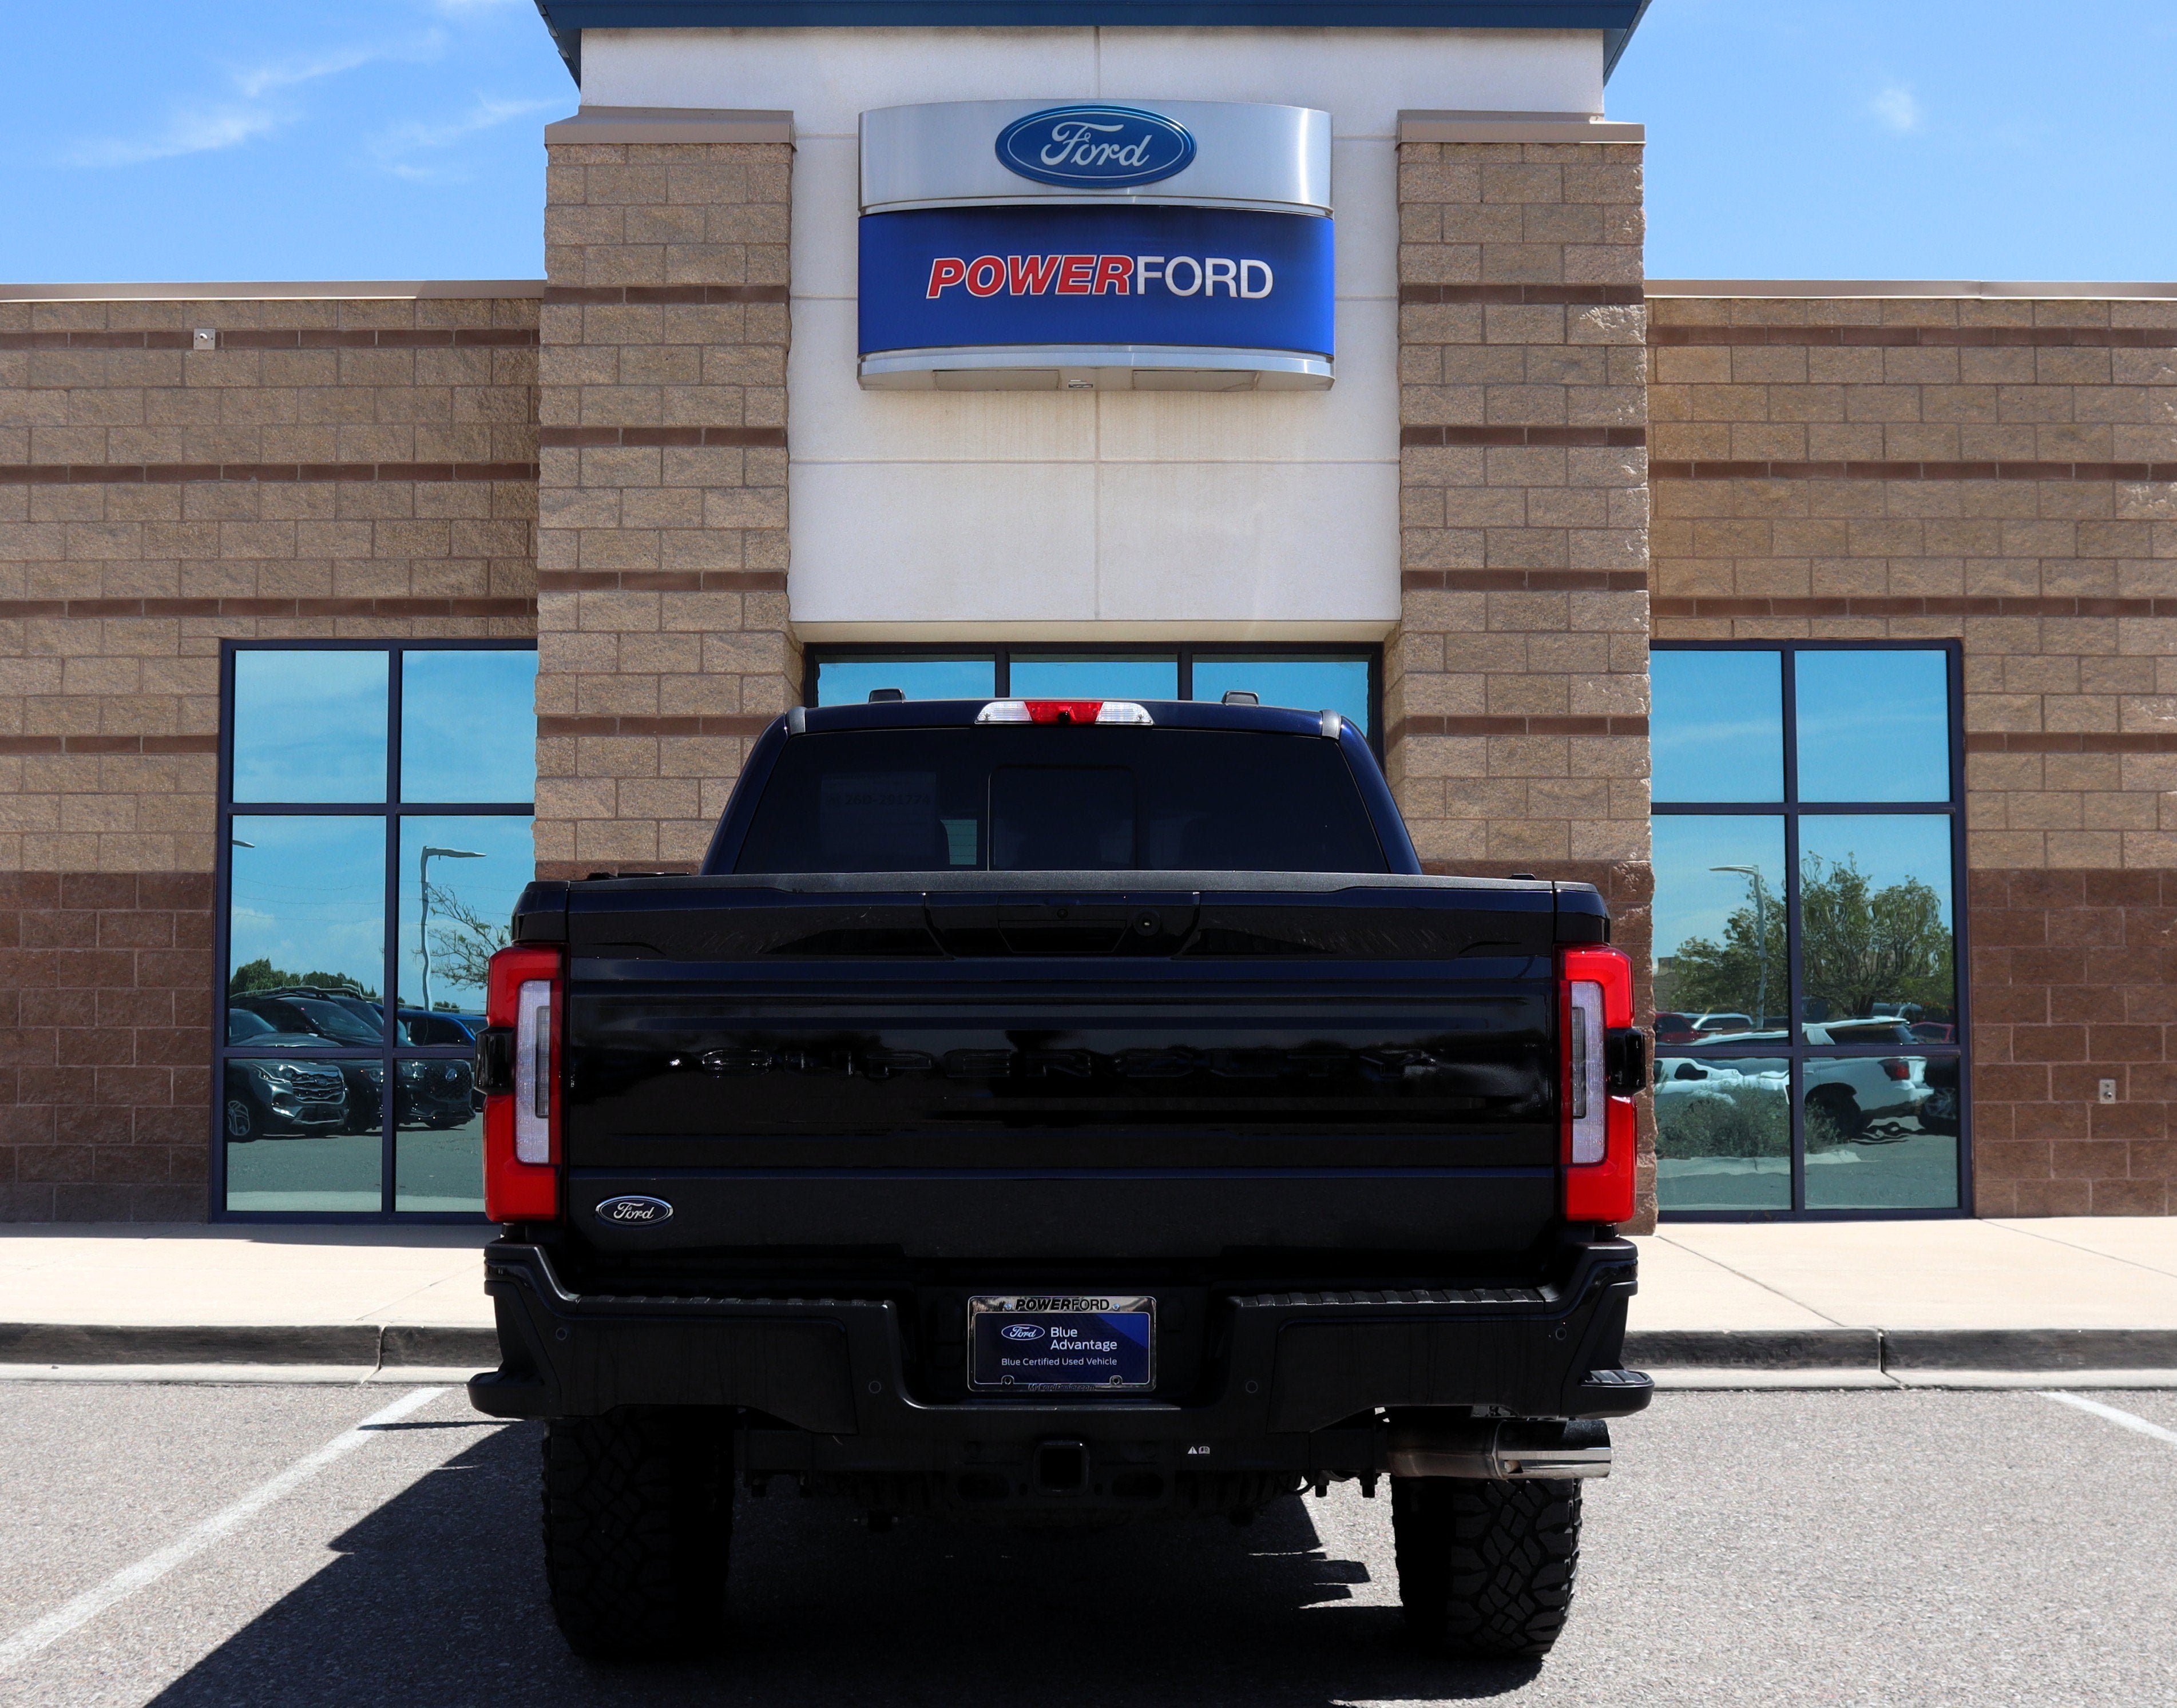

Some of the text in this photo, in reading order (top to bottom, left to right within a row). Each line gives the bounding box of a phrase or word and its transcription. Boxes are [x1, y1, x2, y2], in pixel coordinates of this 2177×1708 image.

[1040, 121, 1152, 168] Ford
[926, 254, 1274, 299] POWERFORD
[613, 1202, 655, 1219] Ford
[1015, 1299, 1109, 1310] POWERFORD
[1010, 1326, 1036, 1338] Ford
[1050, 1327, 1078, 1337] Blue
[1050, 1339, 1117, 1352] Advantage
[1001, 1357, 1117, 1366] Blue Certified Used Vehicle
